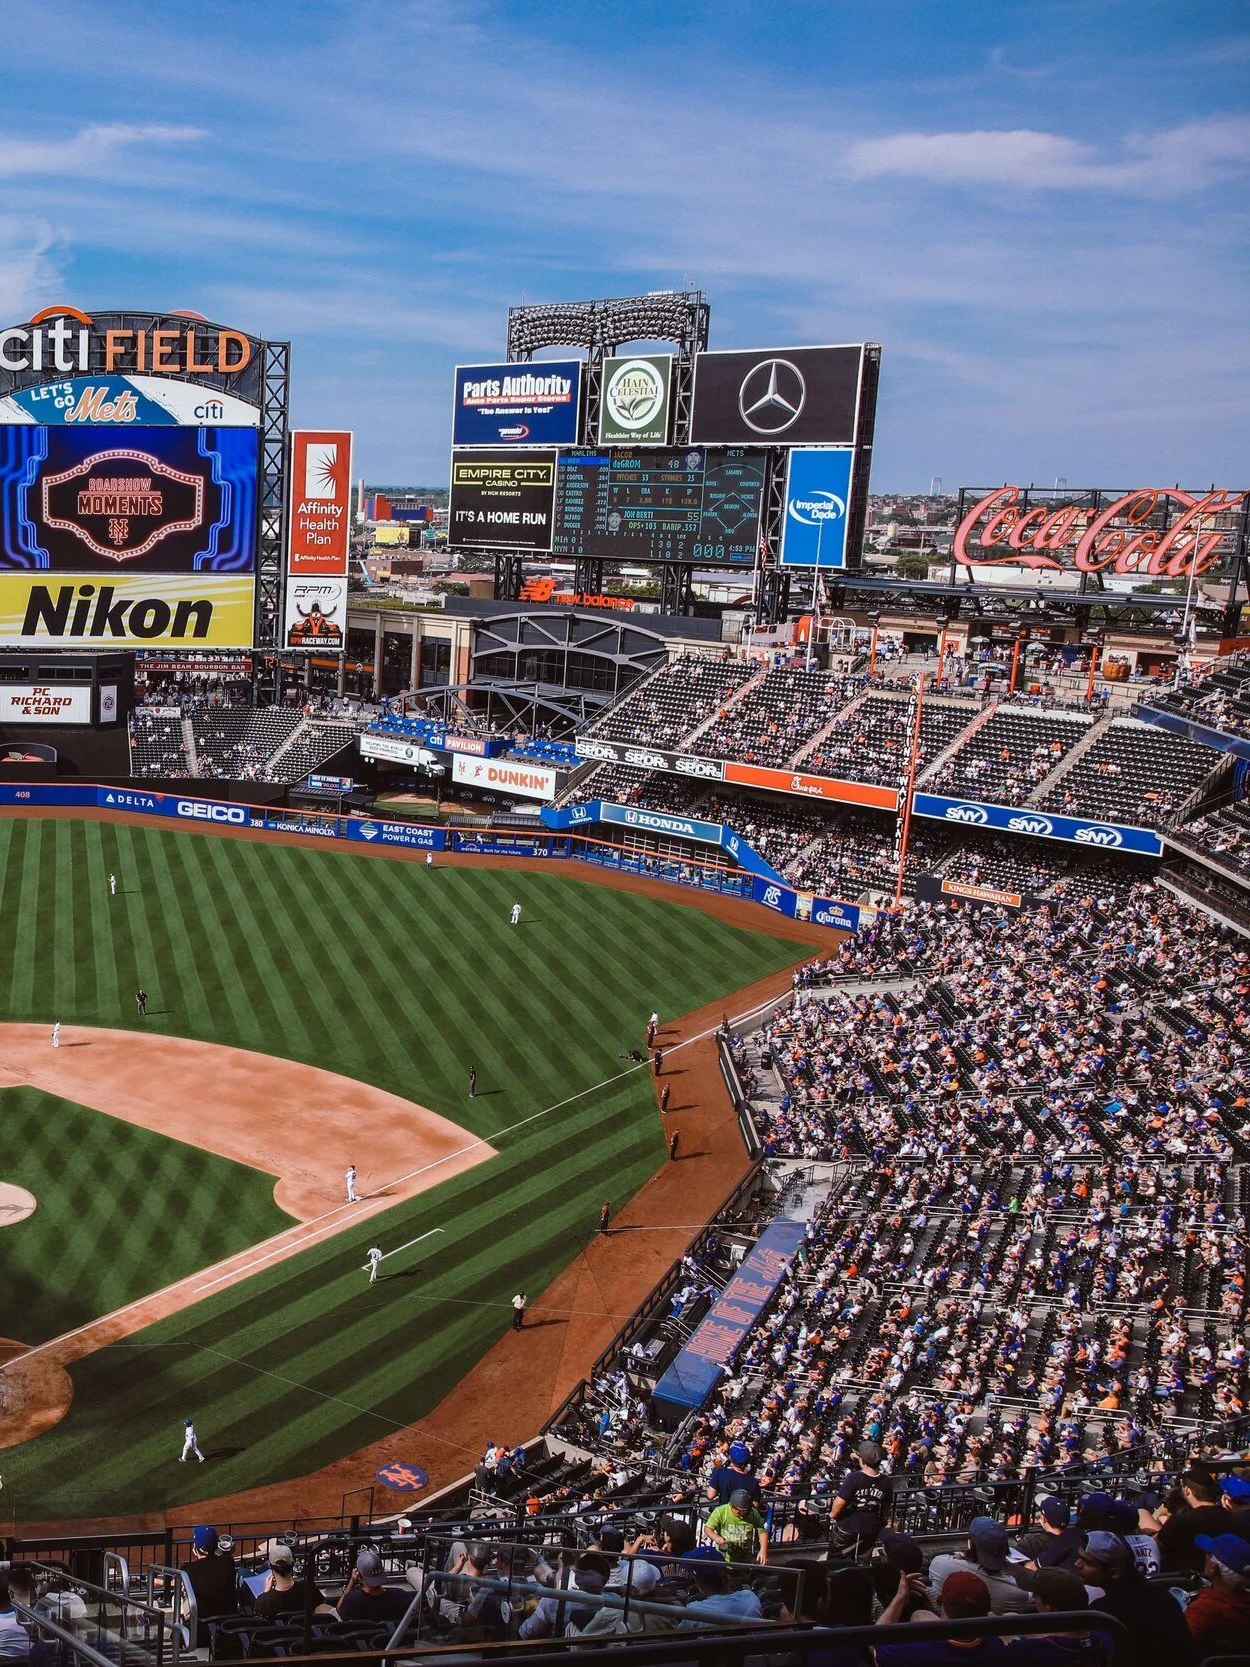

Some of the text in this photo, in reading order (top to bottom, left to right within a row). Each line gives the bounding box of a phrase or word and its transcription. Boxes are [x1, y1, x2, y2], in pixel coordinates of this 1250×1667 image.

[105, 329, 250, 373] FIELD
[463, 373, 571, 398] Parts Authority
[622, 378, 649, 387] HAIN
[30, 381, 73, 402] LET'S
[610, 386, 659, 398] CELESTIAL
[54, 386, 139, 422] GO Mets
[193, 402, 223, 419] citi
[495, 406, 532, 415] Answer Is
[630, 431, 642, 440] Way
[613, 451, 633, 459] JACOB
[612, 459, 680, 469] deGROM 48
[459, 469, 511, 478] EMPIRE
[660, 474, 683, 482] STRIKES
[88, 478, 151, 491] ROADSHOW
[77, 494, 163, 516] MOMENTS
[297, 502, 343, 518] Affinity
[795, 499, 834, 511] Imperial
[455, 510, 547, 525] IT'S A HOME RUN
[623, 511, 636, 519] JON
[686, 512, 700, 521] 55
[811, 509, 837, 520] Dade
[299, 517, 340, 530] Health
[306, 532, 332, 545] Plan
[953, 486, 1250, 577] Coca-Cola
[294, 585, 333, 594] RPM
[20, 583, 214, 639] Nikon
[10, 696, 73, 706] RICHARD
[21, 706, 61, 715] & SON
[430, 735, 482, 752] citi PAVILION
[487, 767, 550, 791] DUNKIN'
[117, 794, 155, 808] DELTA
[177, 801, 245, 823] GEICO
[945, 806, 982, 824] SNY
[250, 819, 263, 828] 380
[276, 822, 336, 837] KONICA MINOLTA
[382, 824, 434, 837] EAST COAST
[637, 813, 695, 834] HONDA
[1007, 816, 1044, 835] SNY
[381, 833, 434, 846] POWER & GAS
[893, 817, 903, 861] FAIR
[1074, 828, 1114, 848] SNY
[532, 848, 548, 856] 370
[763, 886, 782, 905] RTS
[973, 888, 1013, 904] HAWAIIAN
[816, 911, 852, 928] Corona
[685, 1277, 774, 1362] HOME OF THE
